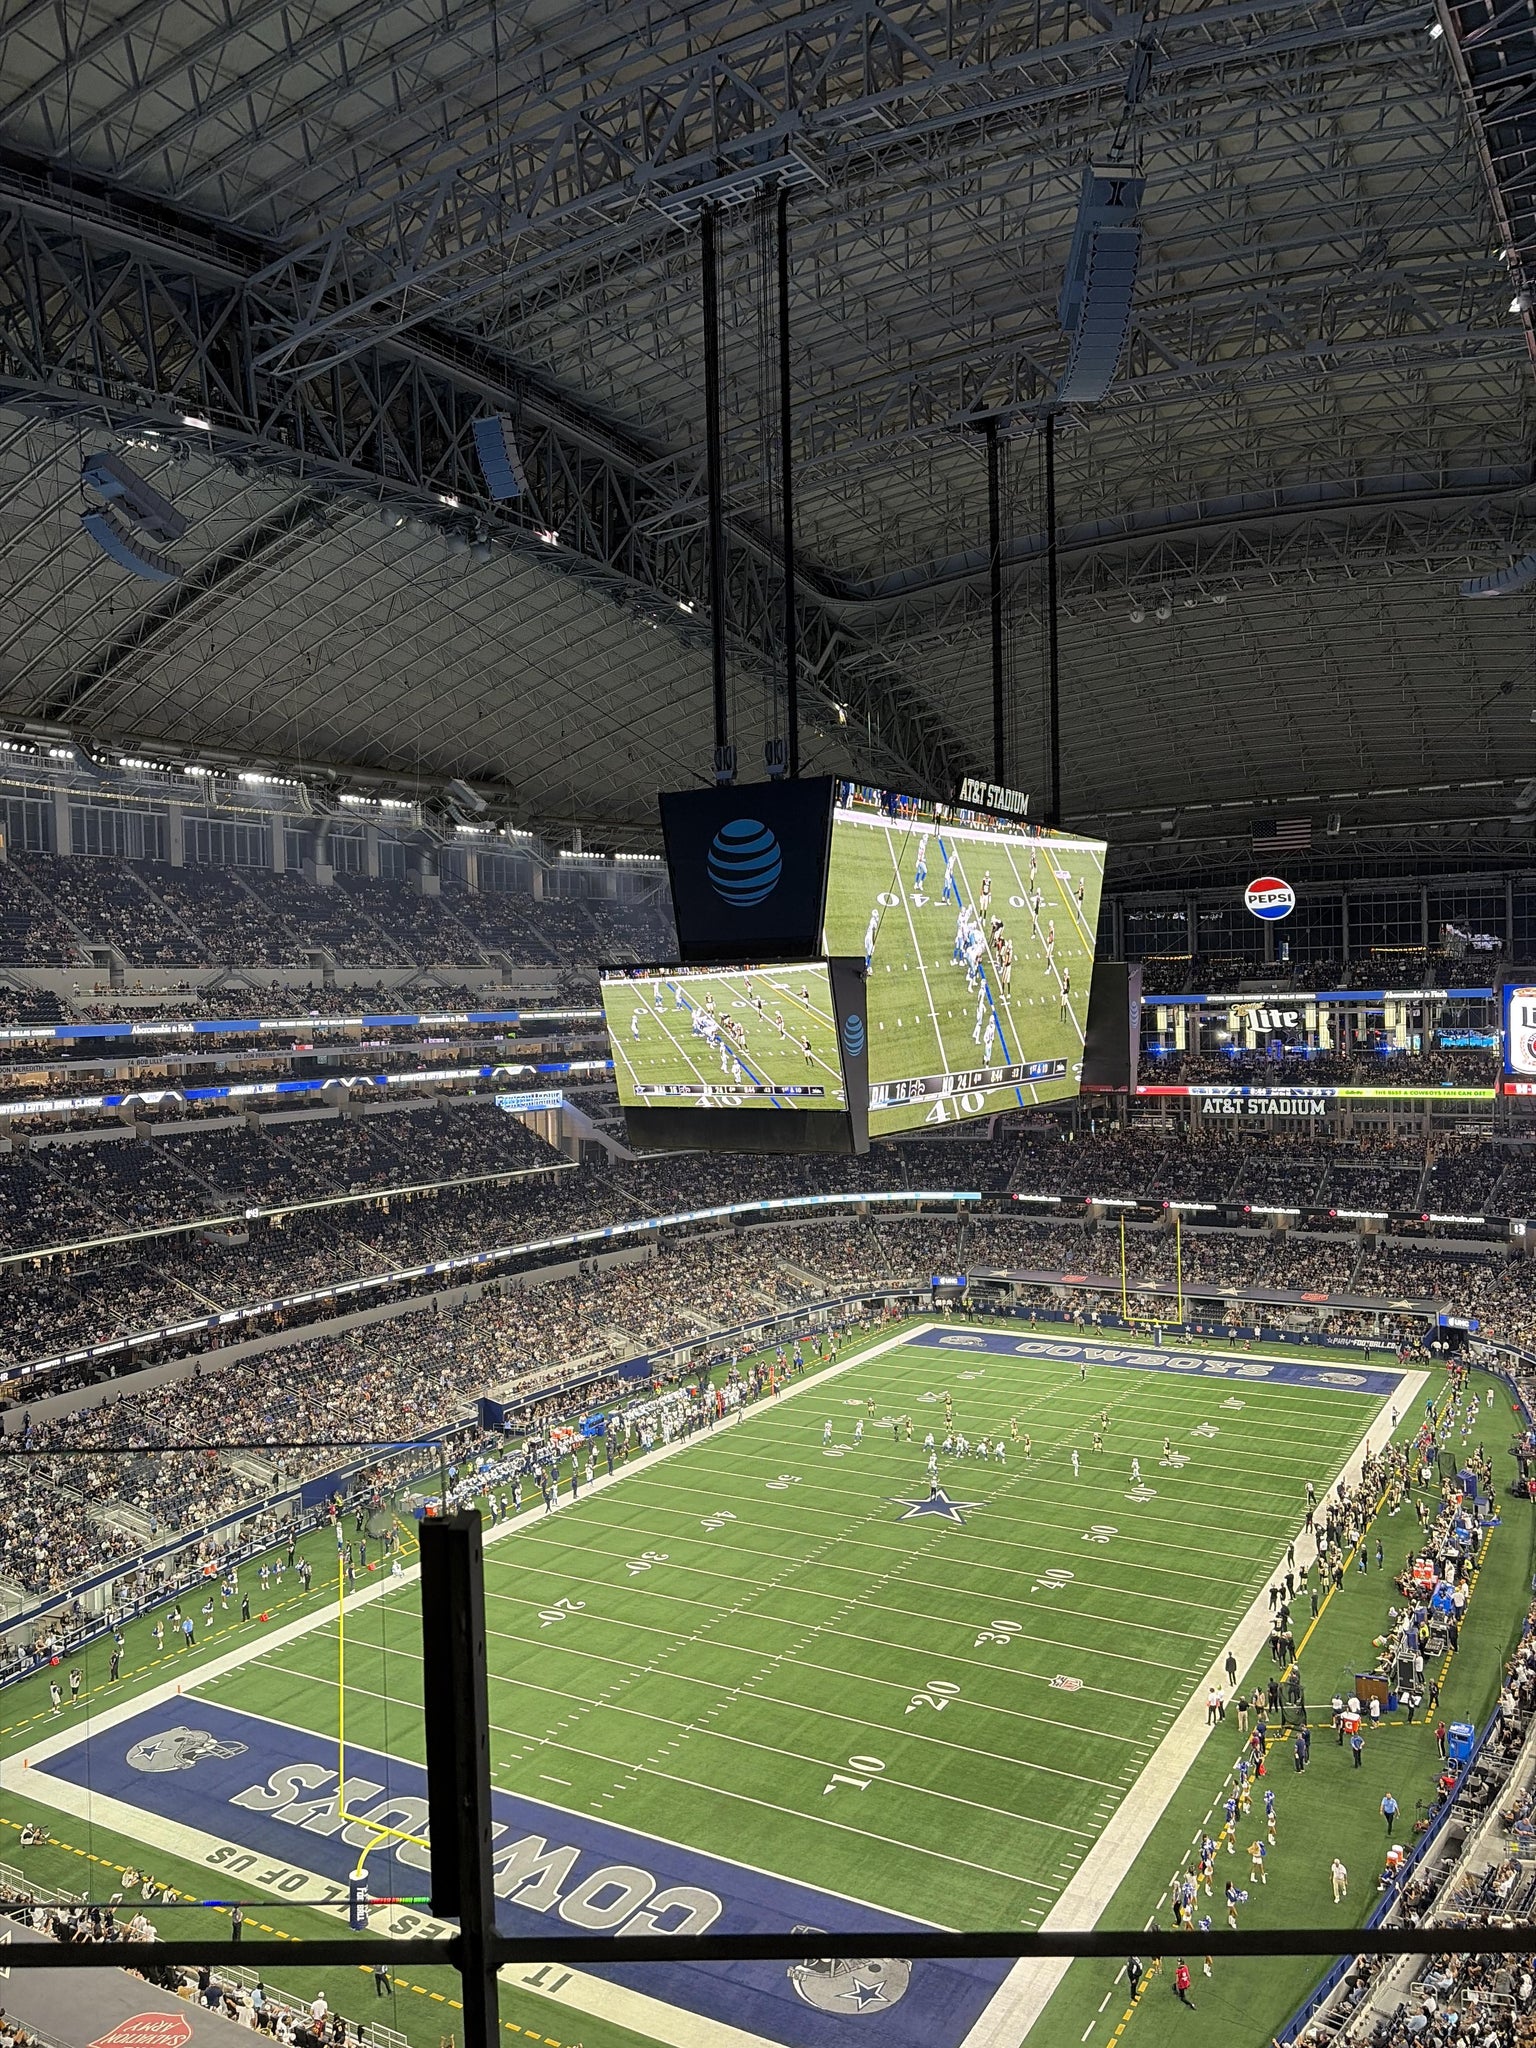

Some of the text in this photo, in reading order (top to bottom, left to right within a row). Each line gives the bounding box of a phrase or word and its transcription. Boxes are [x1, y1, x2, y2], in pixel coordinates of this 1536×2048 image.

[959, 777, 1030, 816] AT&T STADIUM
[1248, 893, 1292, 904] PEPSI
[177, 1023, 195, 1033] Fitch
[1246, 1009, 1298, 1033] Lite
[12, 1065, 44, 1073] MEREDITH
[957, 1074, 968, 1089] 24
[871, 1084, 907, 1104] DAL 16
[54, 1099, 75, 1110] BOWL
[75, 1097, 103, 1109] CLASSIC
[1202, 1098, 1326, 1116] AT&T STADIUM
[1018, 1193, 1061, 1202] Blockchain.com
[1091, 1198, 1137, 1206] Blockchain.com
[1170, 1202, 1217, 1210] Blockchain.com
[1251, 1205, 1300, 1215] Blockchain.com
[1336, 1210, 1389, 1219] Blockchain.com
[1429, 1214, 1485, 1224] Blockchain.com
[1513, 1224, 1526, 1236] 13
[1015, 1341, 1275, 1377] COWBOYS
[1190, 1424, 1220, 1439] 20
[764, 1473, 803, 1491] 50
[1124, 1486, 1158, 1503] 40
[700, 1510, 737, 1528] 40
[1080, 1525, 1119, 1544] 50
[625, 1551, 669, 1571] 30
[1036, 1568, 1075, 1590] 40
[537, 1597, 586, 1622] 20
[977, 1620, 1023, 1646] 30
[910, 1680, 961, 1712] 20
[1345, 1721, 1353, 1730] G
[832, 1755, 886, 1792] 10
[205, 1846, 573, 1994] IT OF US
[122, 2019, 183, 2034] ARMY
[101, 2030, 187, 2047] SALVATION
